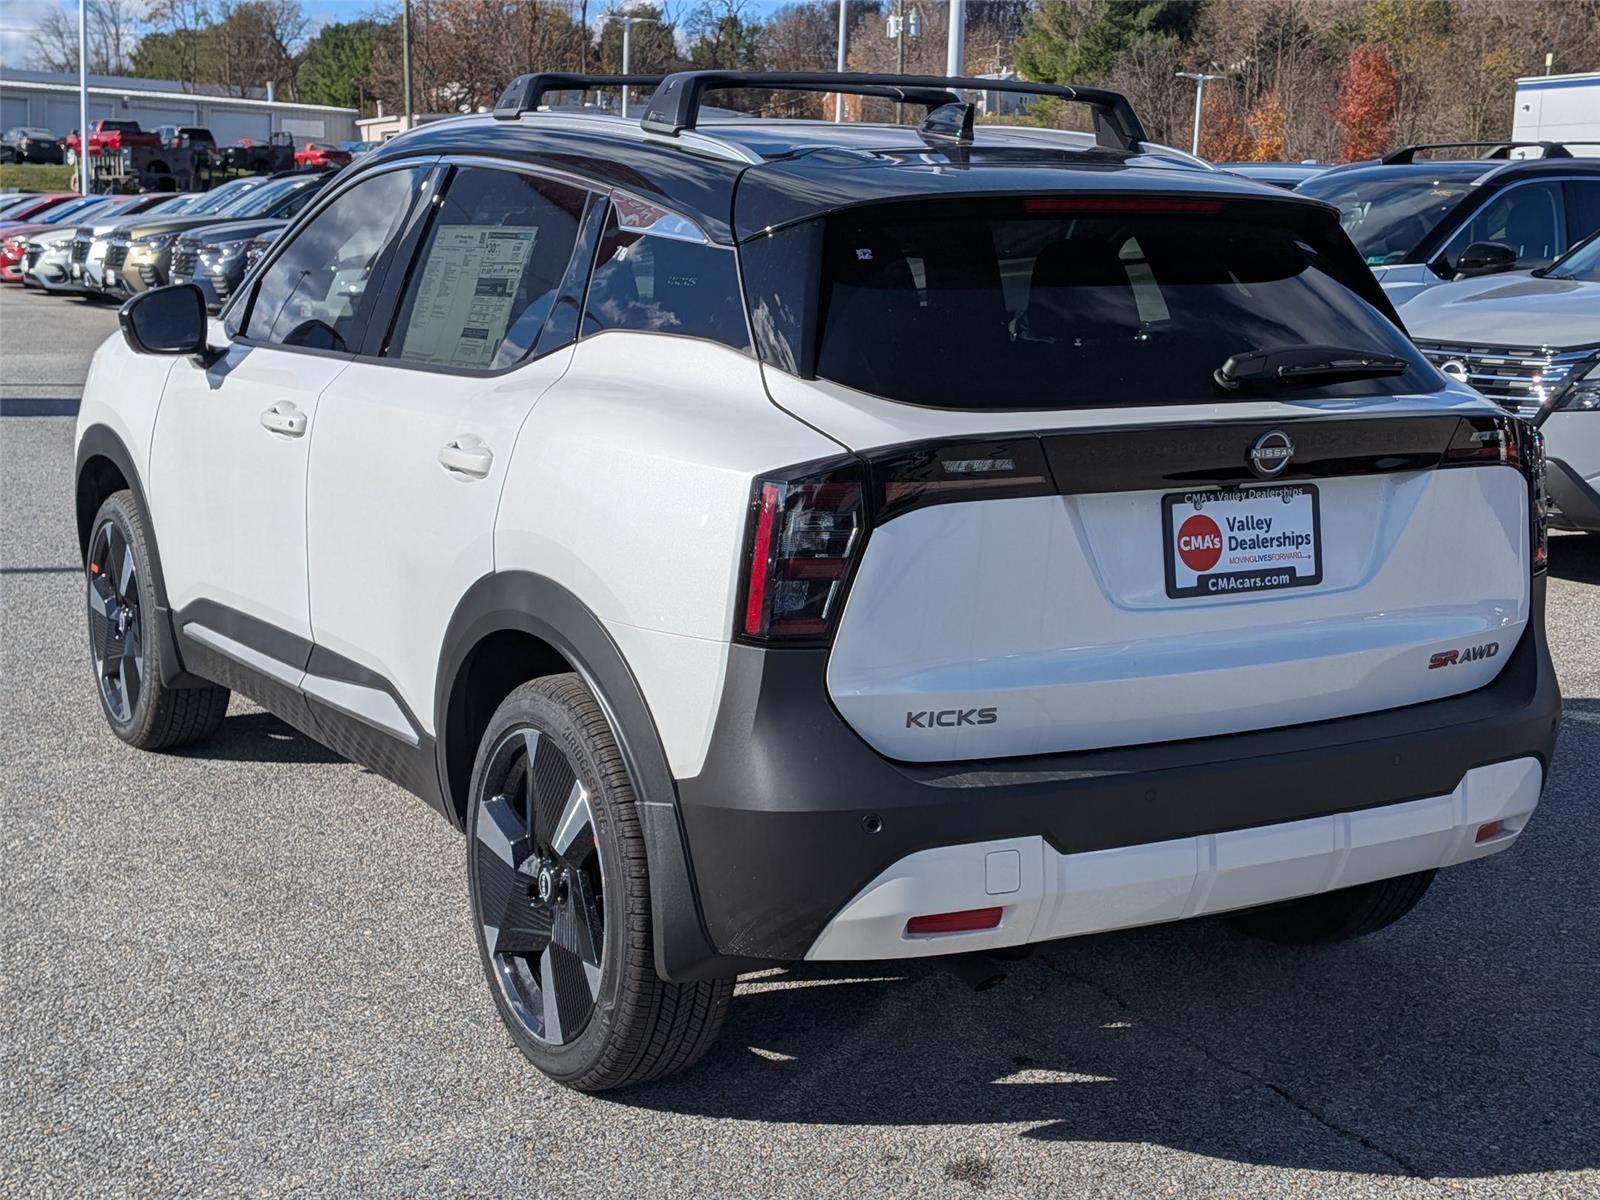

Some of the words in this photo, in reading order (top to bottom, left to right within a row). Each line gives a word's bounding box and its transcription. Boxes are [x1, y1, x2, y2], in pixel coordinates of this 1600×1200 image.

[1251, 446, 1294, 459] NISSAN
[1184, 492, 1215, 504] CMA's
[1217, 490, 1246, 502] Valley
[1249, 487, 1303, 500] Dealerships
[1226, 516, 1272, 533] Valley
[1179, 534, 1221, 551] CMA's
[1228, 531, 1311, 551] Dealerships
[1208, 574, 1290, 591] CMAcars.com
[1428, 649, 1459, 670] SR
[1459, 642, 1499, 664] AWD
[905, 707, 998, 728] KICKS
